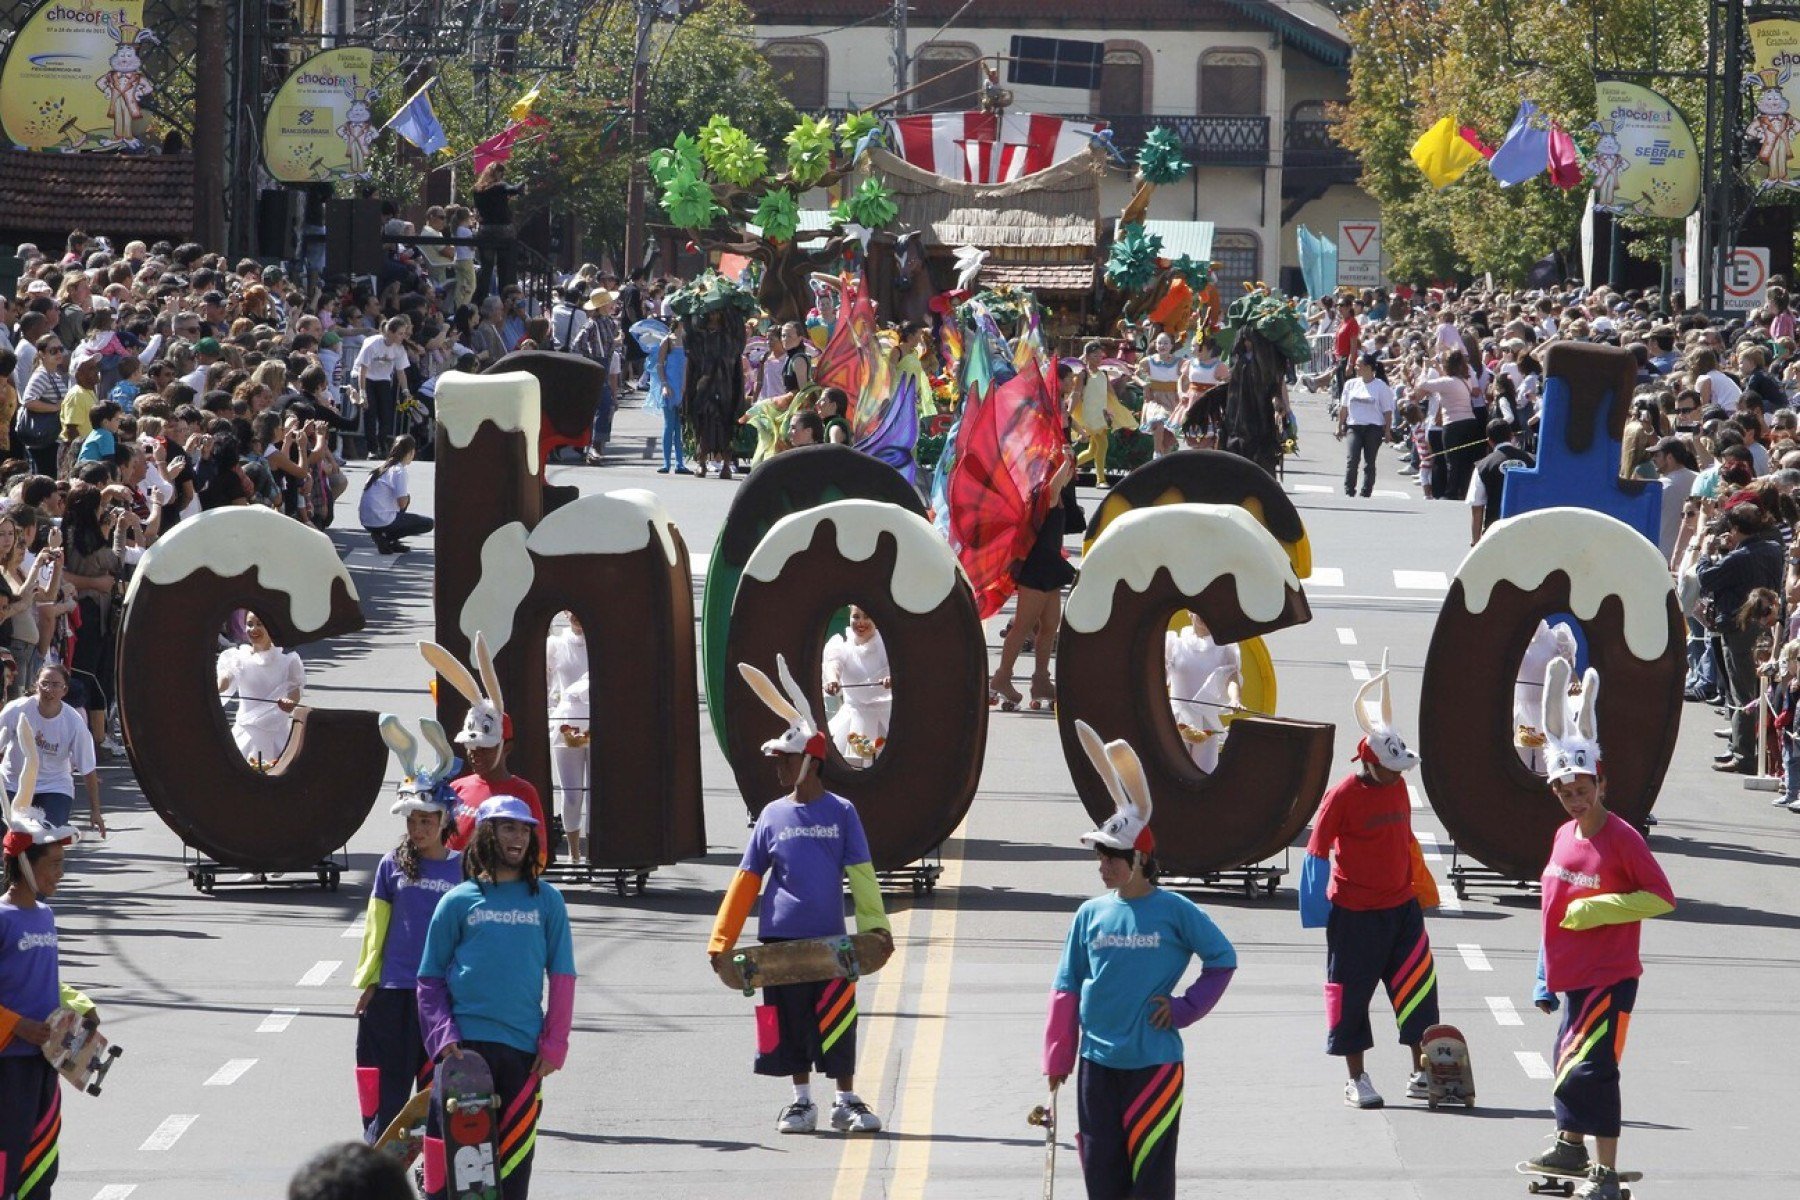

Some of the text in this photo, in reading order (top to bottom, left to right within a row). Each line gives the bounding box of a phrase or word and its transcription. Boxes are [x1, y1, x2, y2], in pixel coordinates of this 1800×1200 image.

[46, 4, 126, 25] chocofest
[296, 72, 357, 87] chocofest
[1610, 106, 1672, 123] chocofest
[1634, 146, 1686, 159] SEBRAE
[1733, 260, 1751, 286] E
[1724, 299, 1762, 308] XCLUSIVO
[778, 823, 840, 841] chocofest
[467, 906, 541, 926] chocofest
[1090, 930, 1160, 951] chocofest
